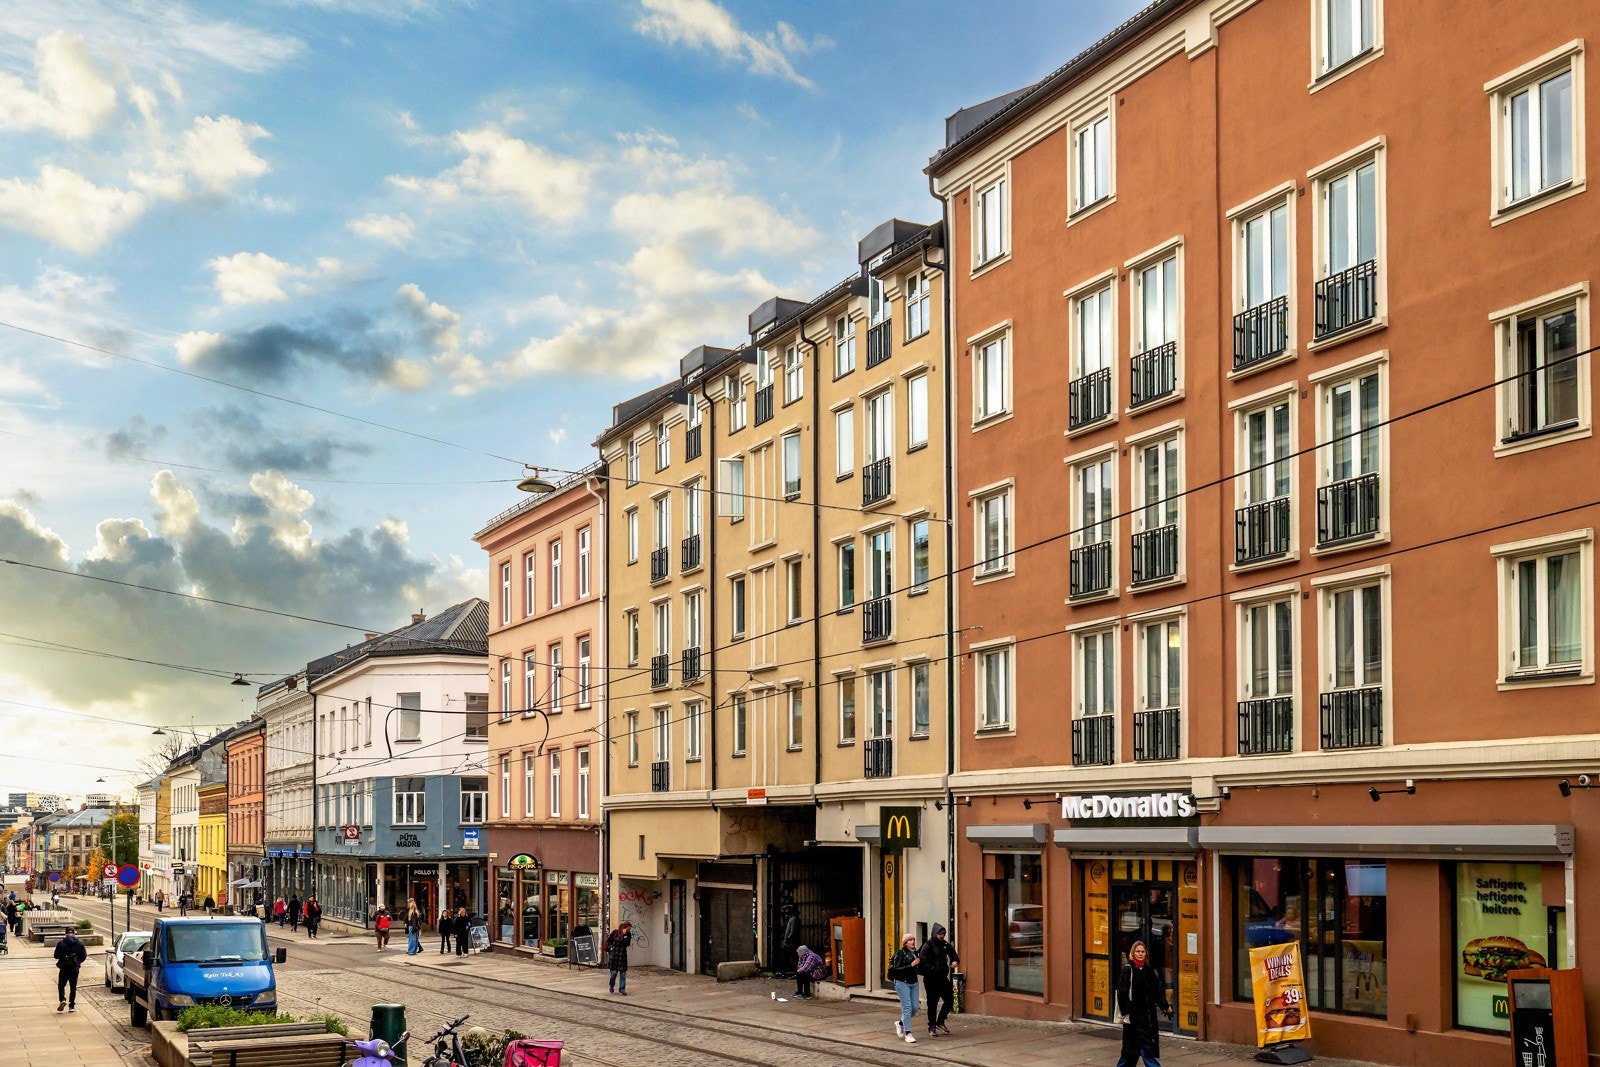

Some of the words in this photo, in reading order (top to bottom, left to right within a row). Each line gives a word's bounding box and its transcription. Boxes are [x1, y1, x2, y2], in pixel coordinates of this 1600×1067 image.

[1061, 792, 1196, 818] McDonald's
[400, 833, 417, 841] PÜTA
[1476, 878, 1526, 891] Saftigere,
[1476, 890, 1527, 904] heftigere,
[1482, 903, 1521, 915] heitere.
